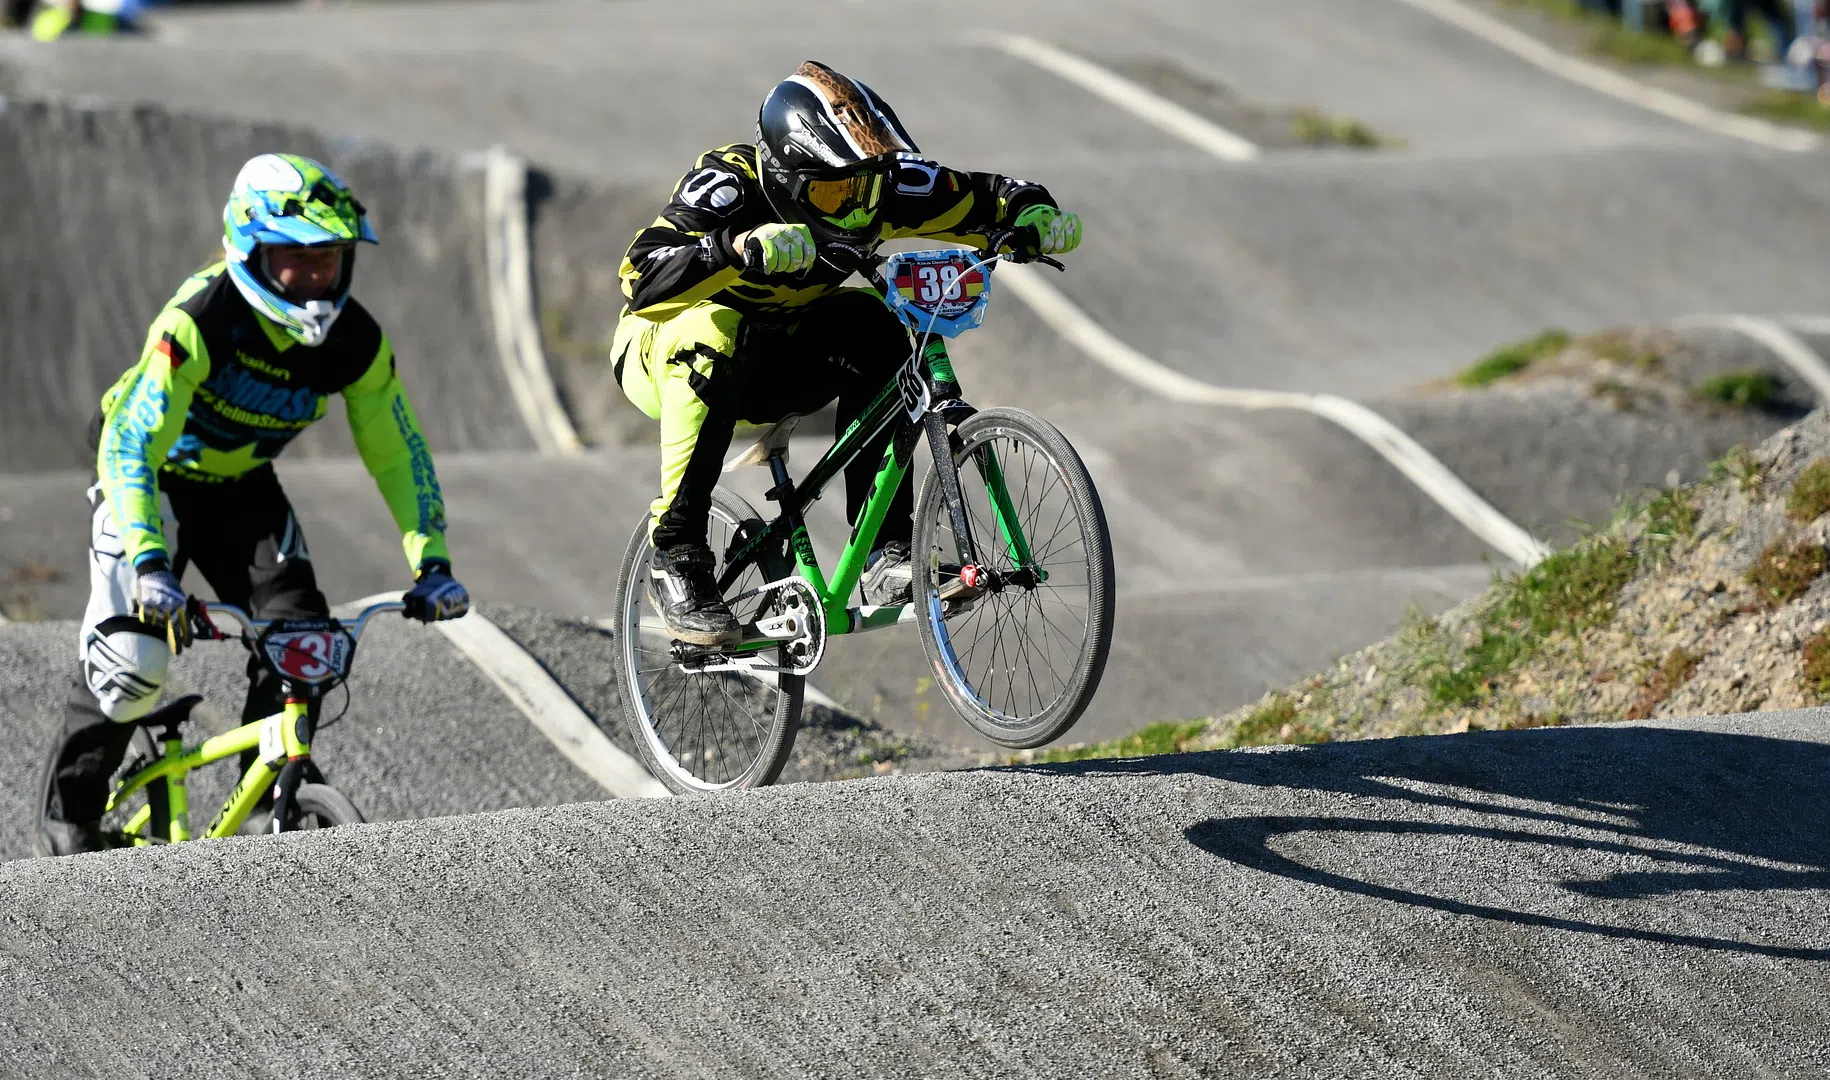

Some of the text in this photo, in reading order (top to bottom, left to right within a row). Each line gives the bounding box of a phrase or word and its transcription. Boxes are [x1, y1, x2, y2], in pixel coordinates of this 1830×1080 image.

[918, 265, 962, 302] 38
[899, 357, 923, 413] 38
[299, 633, 328, 677] 3
